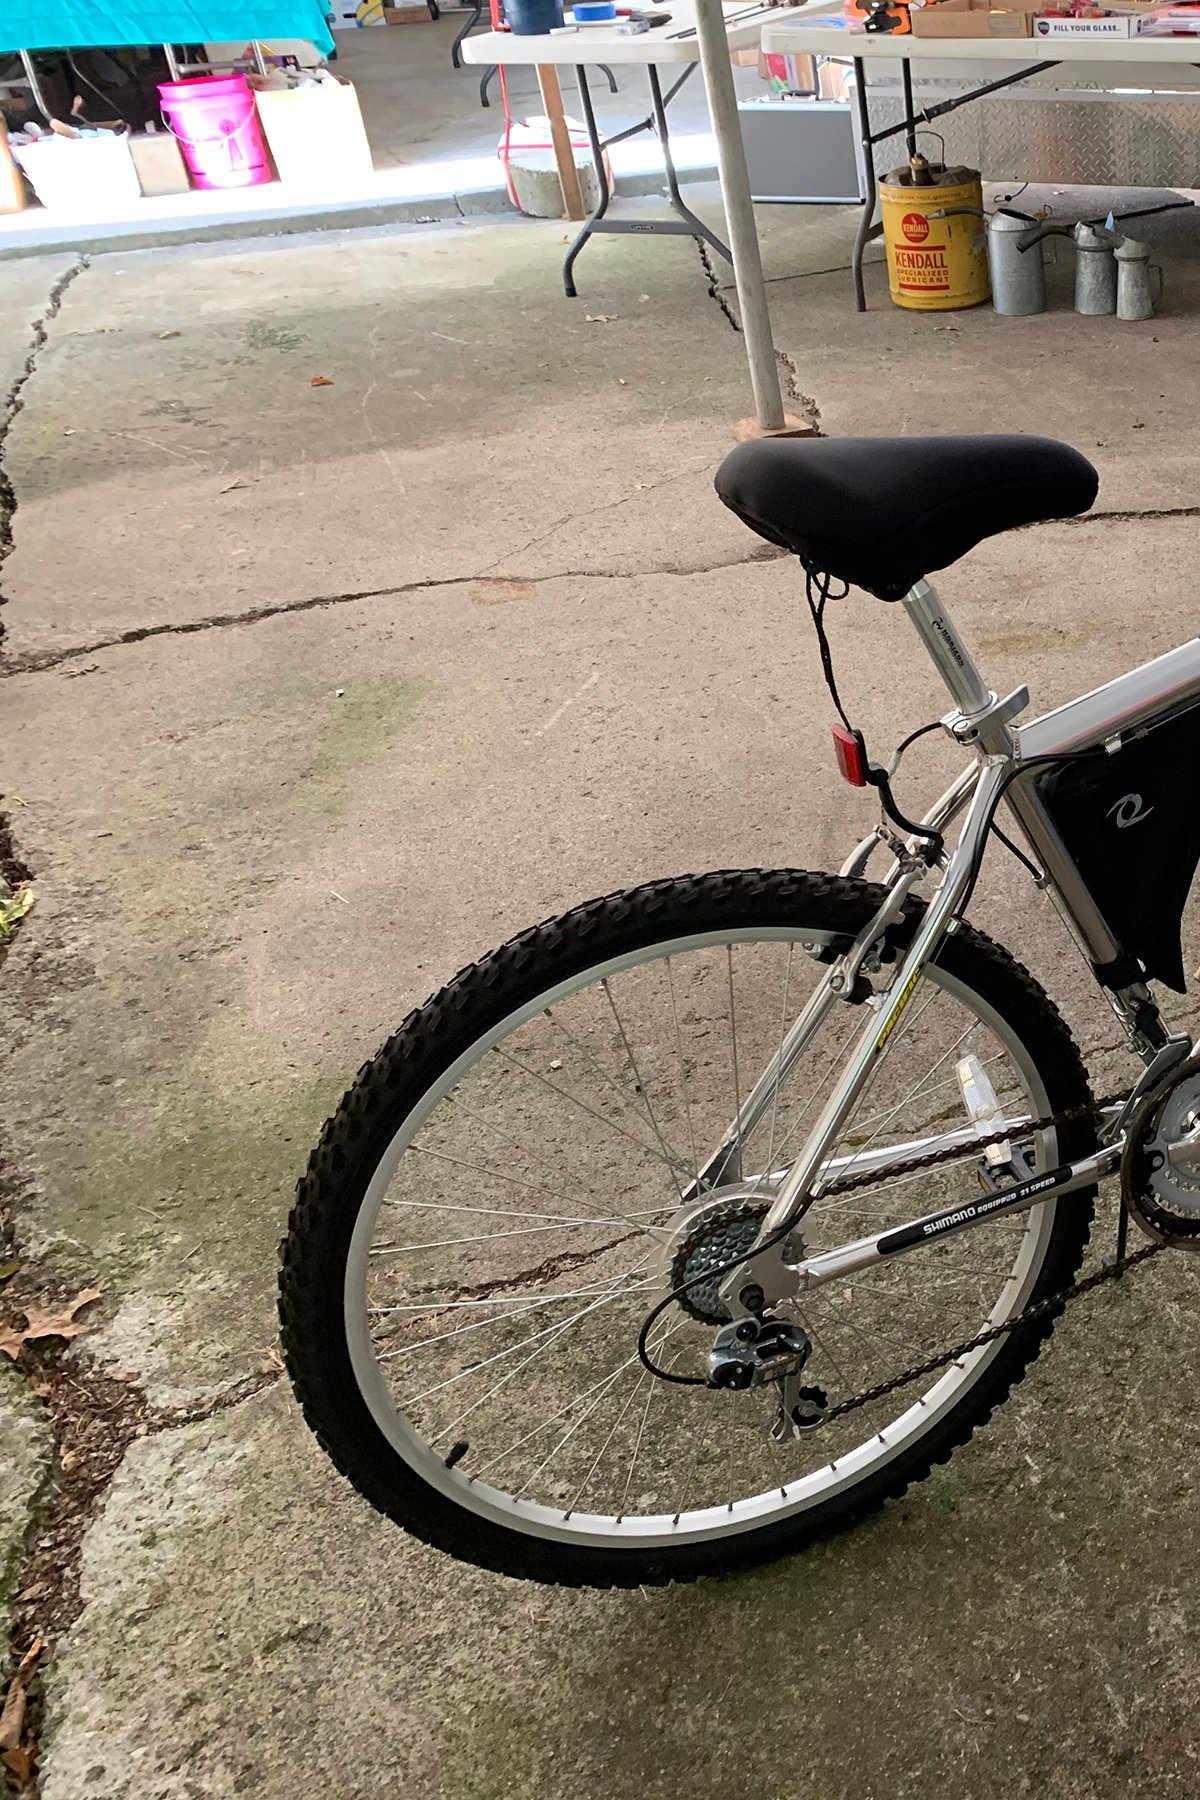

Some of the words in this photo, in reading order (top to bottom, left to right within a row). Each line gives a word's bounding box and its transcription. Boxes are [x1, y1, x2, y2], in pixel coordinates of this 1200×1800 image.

[903, 223, 928, 233] KENDALL
[895, 252, 948, 269] KENDALL
[897, 268, 949, 277] SPECIALIZED
[897, 276, 949, 284] LUBRICANT
[923, 1207, 976, 1235] SHIMANO
[977, 1192, 1017, 1214] EQUIPPED
[1019, 1187, 1030, 1198] 21
[1030, 1176, 1056, 1192] SPEED
